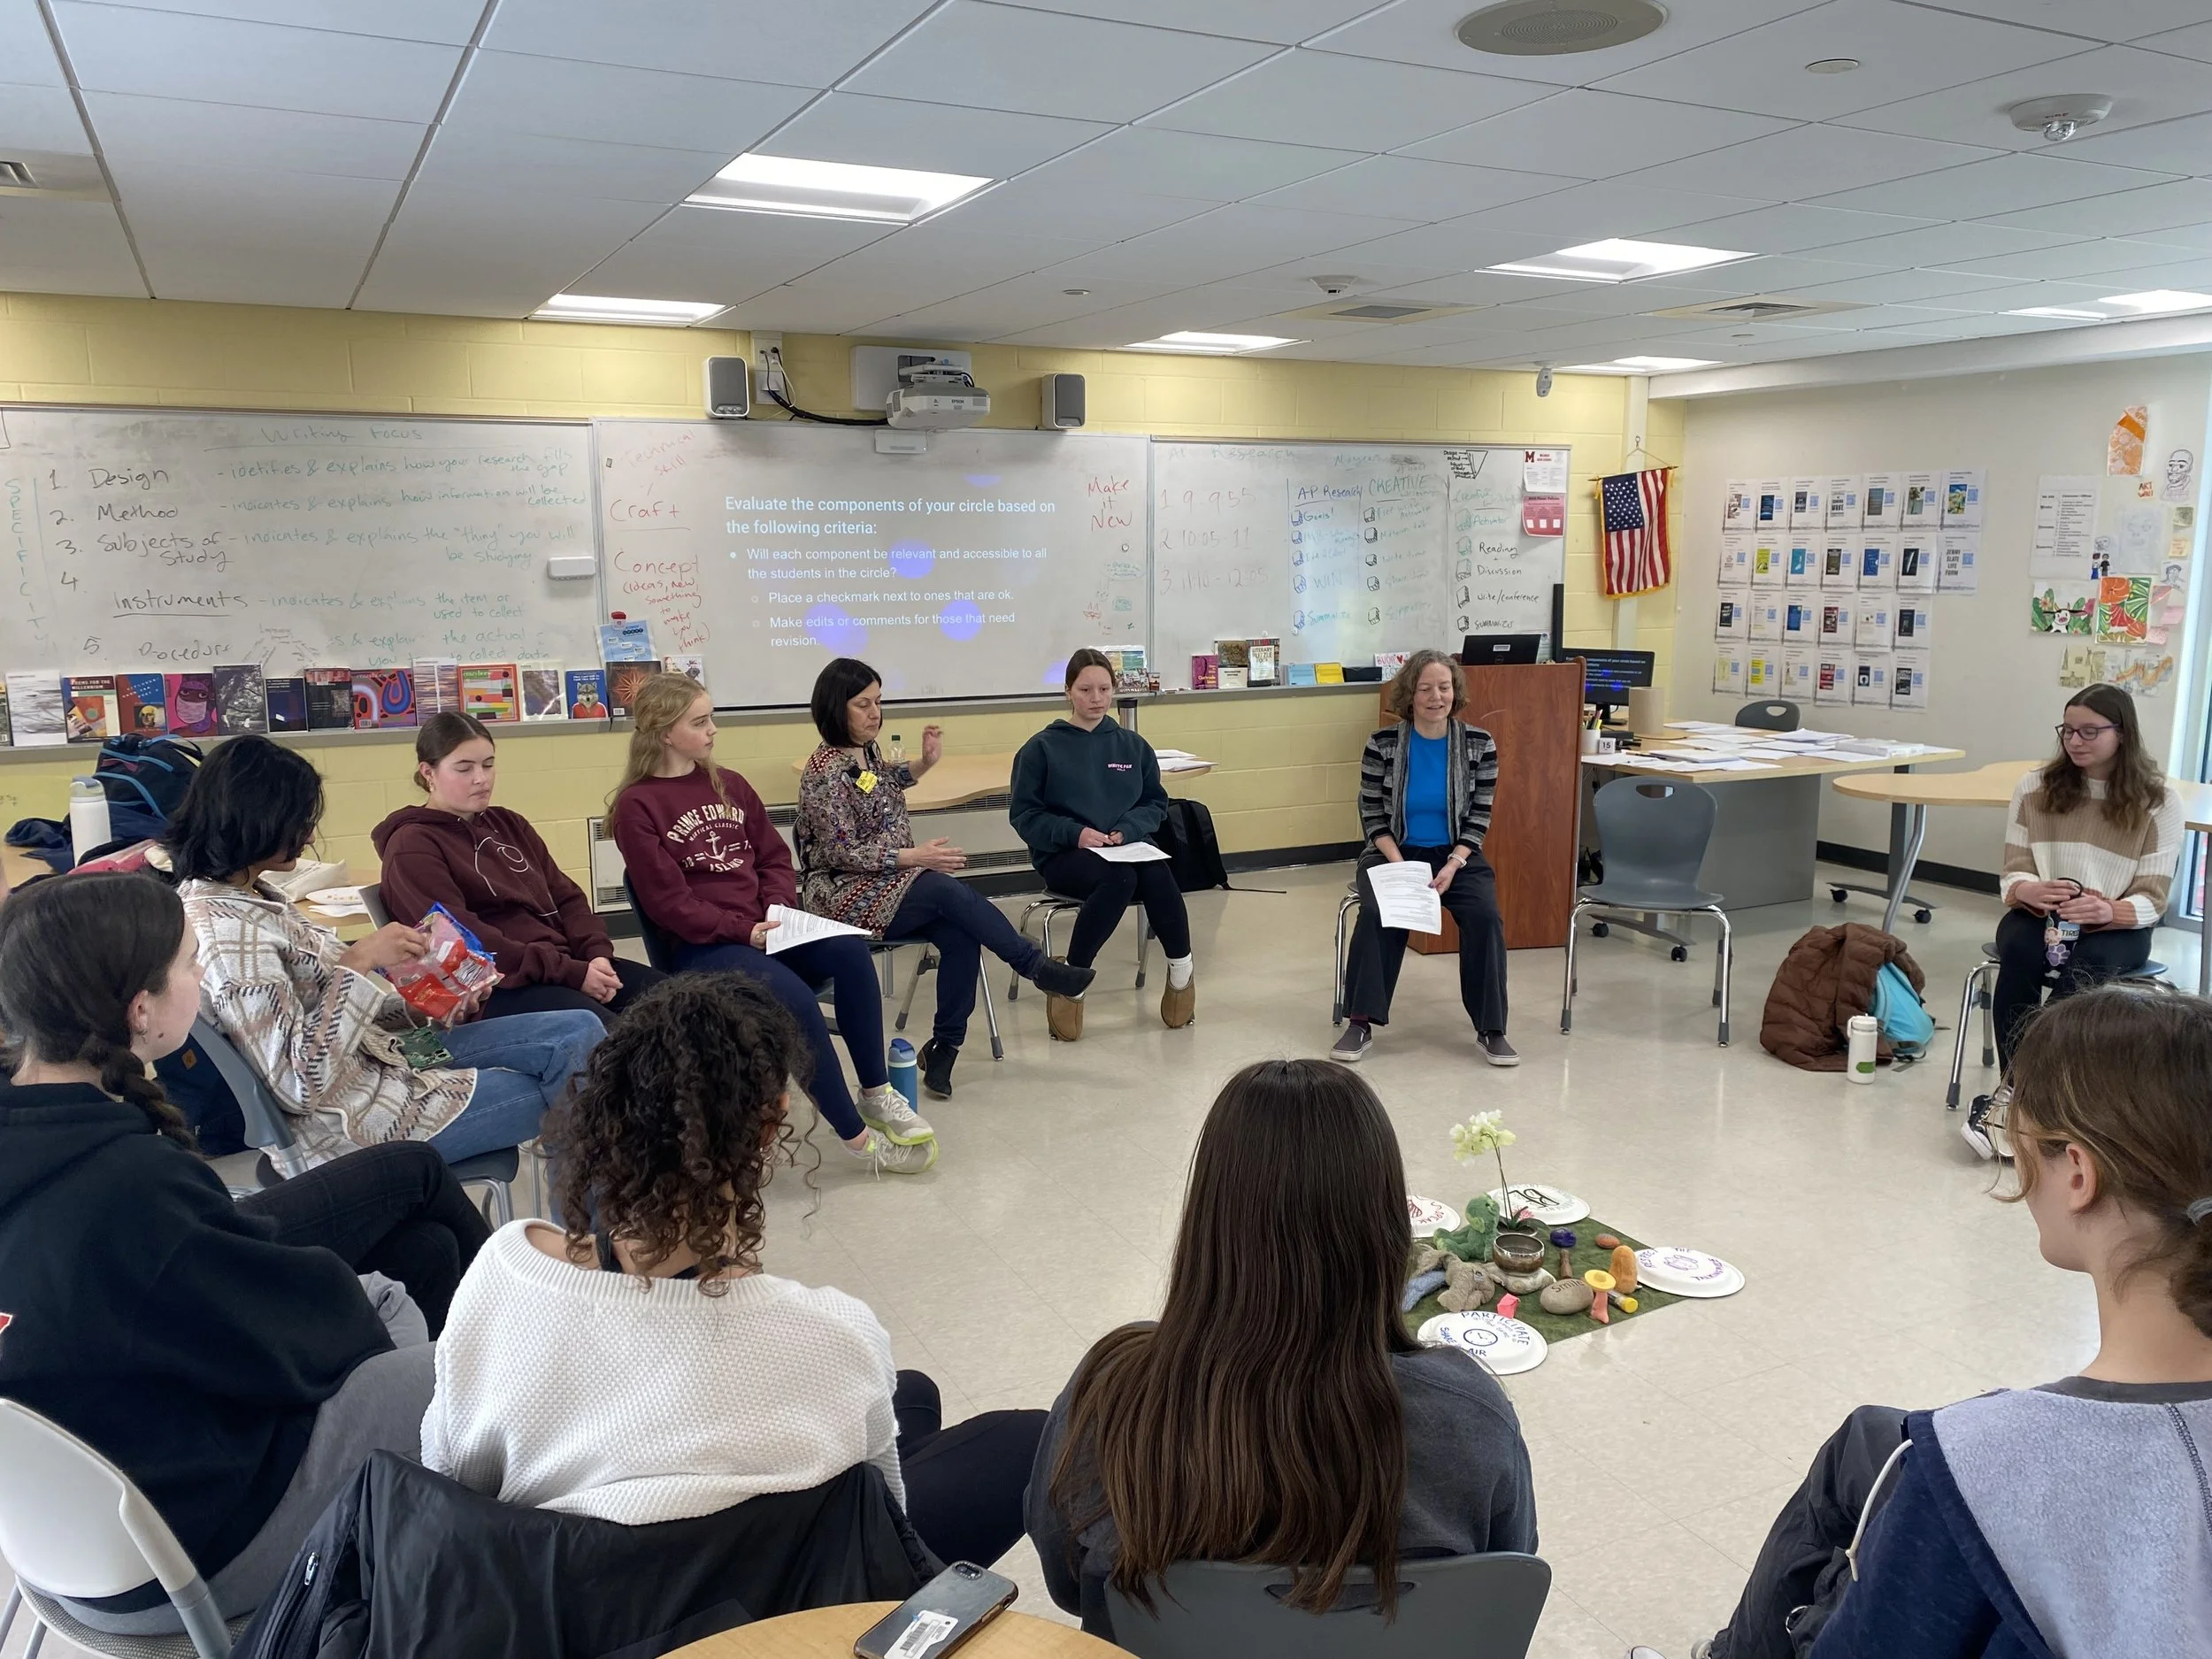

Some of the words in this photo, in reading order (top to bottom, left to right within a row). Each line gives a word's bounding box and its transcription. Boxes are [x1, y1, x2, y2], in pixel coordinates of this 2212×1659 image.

[261, 426, 354, 442] Writing
[371, 426, 423, 440] Focus
[1525, 451, 1535, 463] M
[49, 470, 67, 489] 1.
[88, 468, 169, 490] Design
[307, 459, 319, 477] &
[326, 457, 397, 477] explains
[404, 456, 435, 470] how
[479, 452, 534, 466] research
[537, 463, 569, 478] gap
[1087, 475, 1130, 497] Make
[50, 511, 74, 526] 2.
[97, 504, 179, 522] Method
[233, 498, 300, 511] indicates
[307, 496, 322, 511] &
[327, 495, 392, 512] explains
[401, 489, 433, 503] how
[439, 488, 511, 503] information
[527, 491, 587, 507] collected
[726, 496, 787, 511] Evaluate
[791, 497, 814, 511] the
[818, 499, 904, 514] components
[909, 498, 922, 511] of
[926, 502, 955, 515] your
[959, 499, 995, 512] circle
[998, 499, 1036, 512] based
[1040, 503, 1055, 512] on
[1102, 496, 1117, 510] it
[610, 499, 680, 522] Craft
[726, 519, 749, 534] the
[754, 519, 819, 537] following
[824, 521, 877, 534] criteria:
[1091, 509, 1133, 531] New
[56, 540, 83, 555] 3.
[97, 531, 194, 557] Subjects
[202, 532, 223, 548] of
[245, 528, 319, 543] indicates
[325, 529, 338, 545] &
[347, 527, 419, 549] explains
[425, 526, 450, 541] the
[510, 531, 540, 546] you
[549, 526, 574, 540] will
[446, 547, 465, 560] be
[747, 549, 769, 560] Will
[772, 549, 802, 560] each
[806, 549, 871, 562] component
[874, 549, 887, 559] be
[892, 549, 935, 559] relevant
[940, 549, 960, 558] and
[964, 548, 1018, 559] accessible
[1022, 549, 1032, 558] to
[1035, 548, 1047, 558] all
[1479, 542, 1519, 558] Reading
[160, 549, 234, 573] Study
[614, 551, 700, 580] Concept
[748, 568, 766, 579] the
[771, 567, 821, 579] students
[825, 567, 834, 579] in
[839, 567, 856, 578] the
[860, 566, 896, 578] circle?
[1477, 565, 1522, 576] Discussion
[113, 589, 248, 611] Instruments
[272, 593, 343, 607] indicates
[349, 594, 364, 608] &
[435, 593, 455, 604] the
[769, 592, 803, 603] Place
[806, 594, 813, 603] a
[818, 591, 879, 603] checkmark
[883, 592, 907, 602] next
[910, 592, 920, 602] to
[924, 592, 950, 601] ones
[954, 590, 974, 601] that
[978, 591, 995, 600] are
[998, 590, 1014, 600] ok.
[434, 609, 462, 619] used
[473, 609, 483, 618] to
[488, 605, 525, 618] collect
[664, 610, 691, 625] make
[770, 617, 803, 627] Make
[806, 616, 833, 626] edits
[838, 618, 849, 626] or
[853, 615, 910, 626] comments
[915, 614, 929, 625] for
[933, 613, 963, 625] those
[965, 613, 986, 623] that
[988, 612, 1015, 623] need
[351, 634, 363, 645] &
[443, 630, 466, 644] the
[475, 629, 526, 643] actual
[673, 624, 692, 641] you
[771, 636, 820, 647] revision.
[368, 657, 397, 667] you
[469, 650, 508, 661] collect
[666, 809, 703, 844] PRINCE
